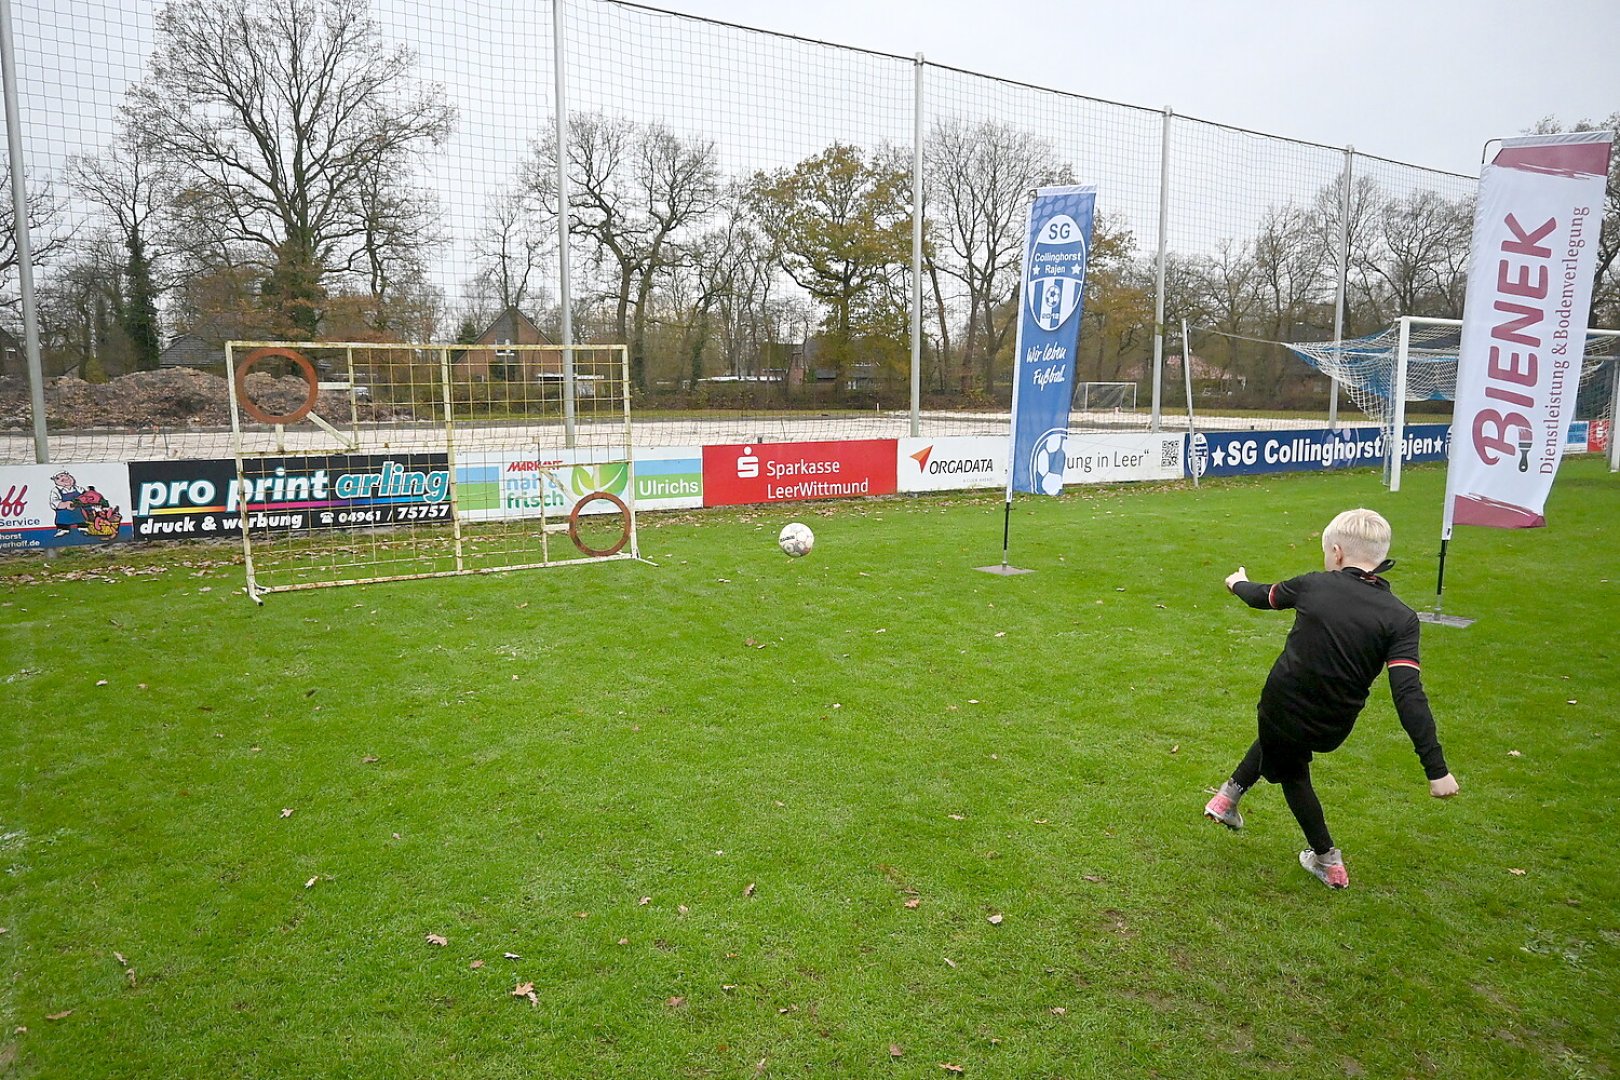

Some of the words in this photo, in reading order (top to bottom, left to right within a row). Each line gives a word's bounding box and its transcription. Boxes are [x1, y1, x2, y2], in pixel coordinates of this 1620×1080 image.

[1048, 223, 1070, 240] SG
[1034, 252, 1082, 264] Collinghorst
[1044, 264, 1066, 276] Rajen
[1553, 206, 1591, 341] Bodenverlegung
[1472, 212, 1557, 465] BIENEK
[1026, 344, 1043, 363] Wir
[1551, 342, 1568, 355] &
[1540, 360, 1570, 475] Dienstleistung
[1097, 452, 1109, 468] in
[1227, 440, 1258, 467] SG
[766, 459, 840, 479] Sparkasse
[929, 458, 994, 475] ORGADATA
[137, 480, 216, 517] pro
[226, 466, 329, 513] print
[335, 461, 450, 504] arling
[639, 478, 699, 496] Ulrichs
[767, 477, 869, 499] LeerWittmund
[507, 490, 565, 509] frisch
[140, 516, 197, 535] druck
[201, 515, 218, 531] &
[338, 510, 382, 524] 04961
[397, 504, 450, 520] 75757
